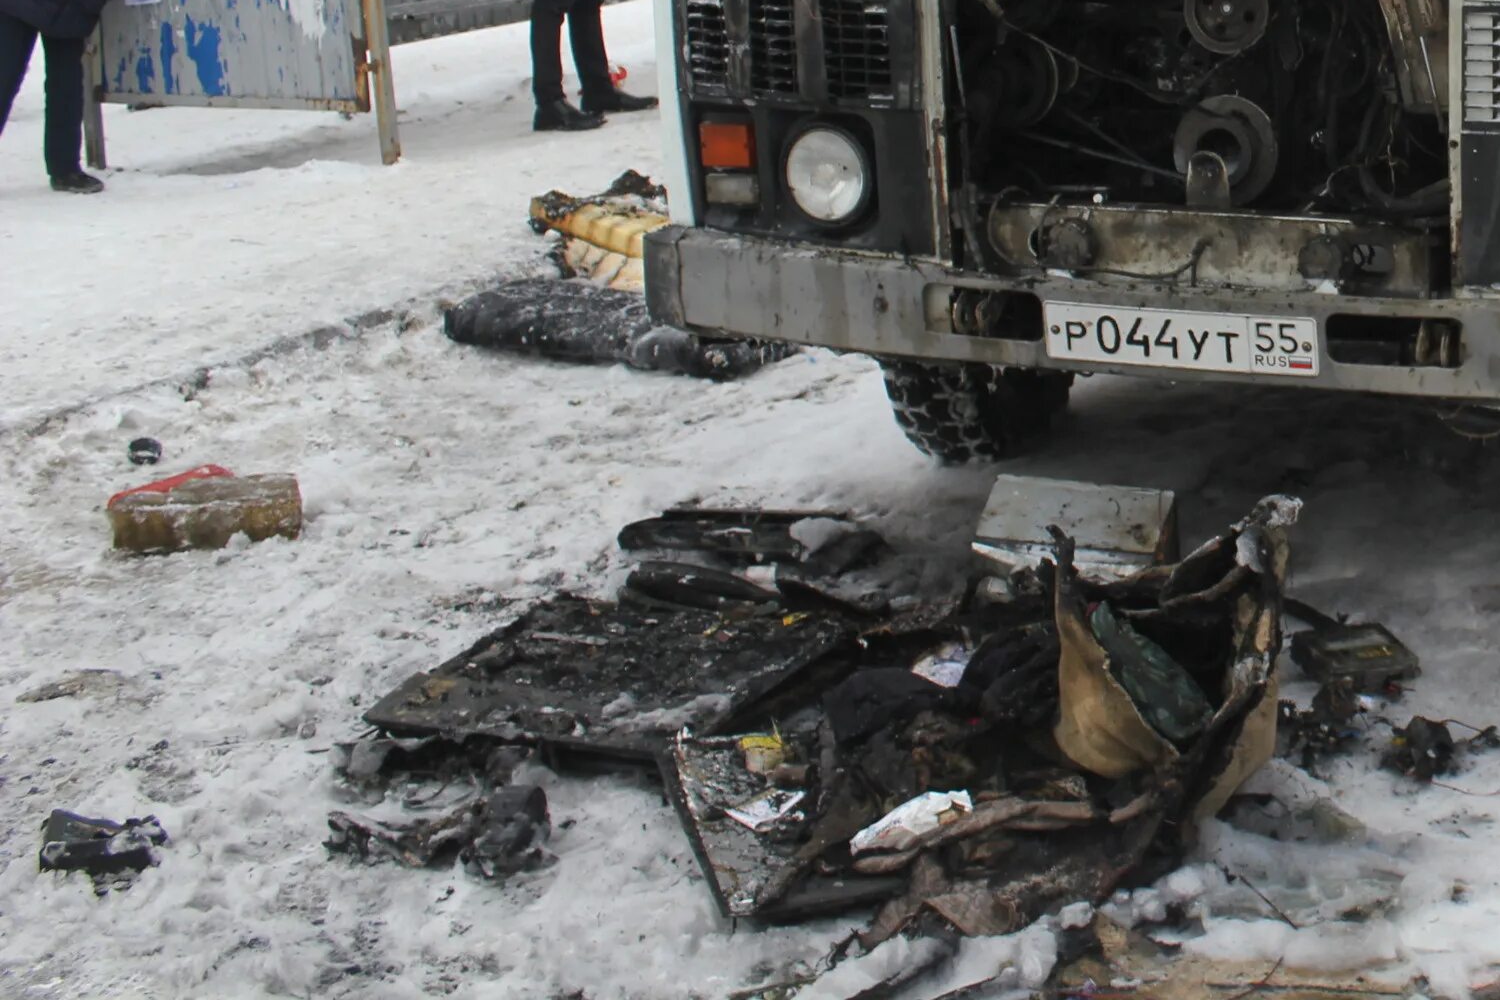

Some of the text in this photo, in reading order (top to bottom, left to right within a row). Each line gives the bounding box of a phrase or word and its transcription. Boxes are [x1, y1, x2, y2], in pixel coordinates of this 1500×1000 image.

[1065, 314, 1299, 364] Р044УТ 55
[1254, 354, 1288, 368] RUS
